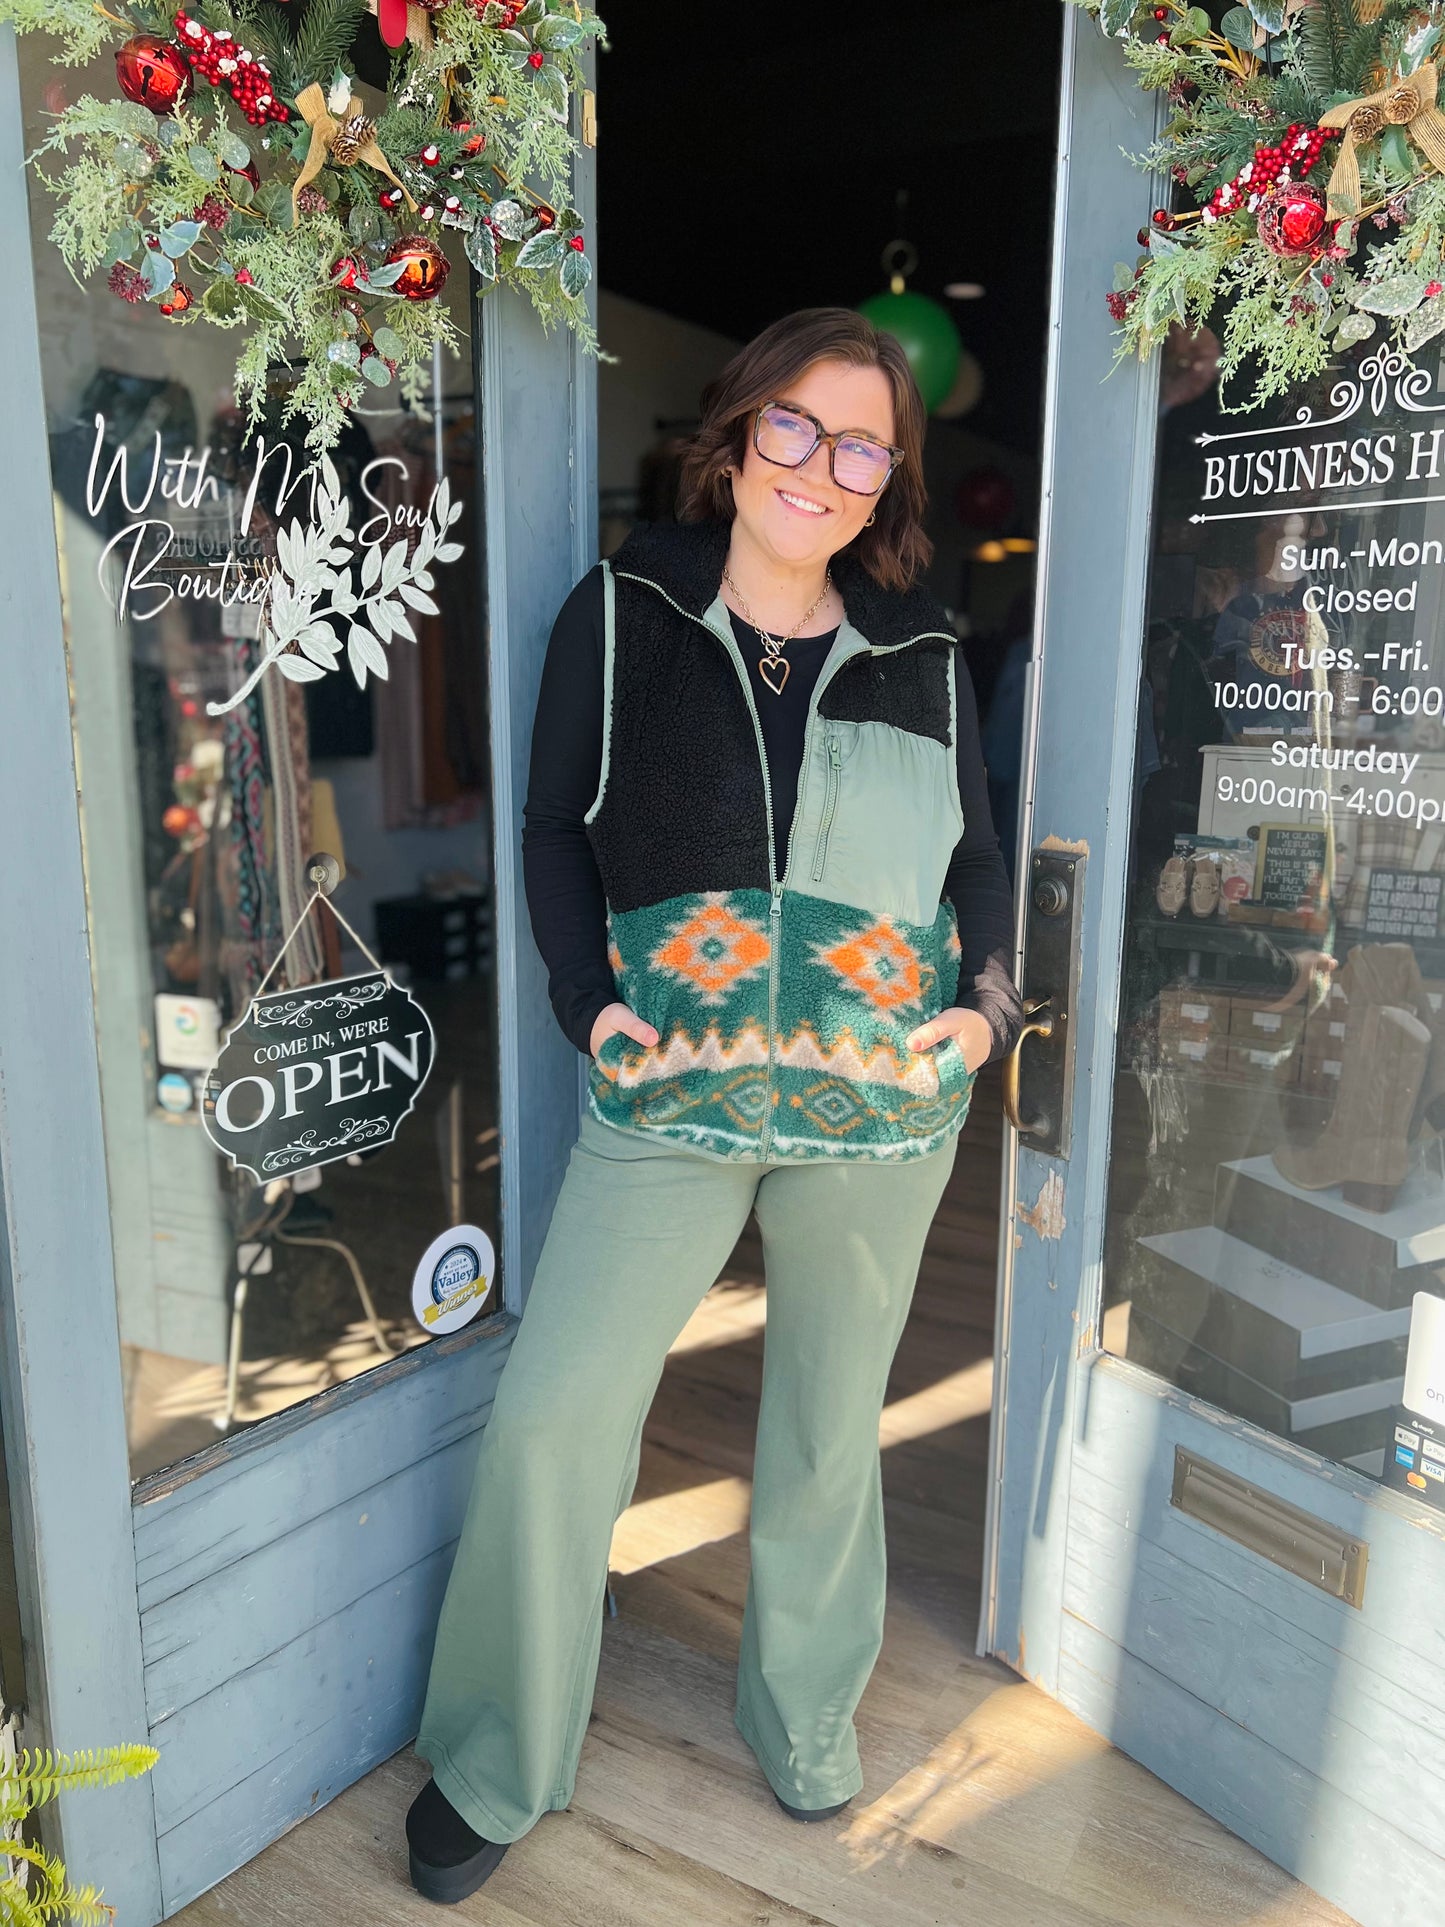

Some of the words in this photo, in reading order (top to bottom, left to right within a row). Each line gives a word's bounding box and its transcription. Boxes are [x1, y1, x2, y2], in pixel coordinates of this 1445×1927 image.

[87, 413, 218, 517] With
[1202, 435, 1396, 500] BUSINESS
[1302, 581, 1417, 613] Closed
[1213, 682, 1334, 712] 10:00am
[1371, 685, 1445, 728] 6:00
[1271, 740, 1419, 784] Saturday
[1217, 775, 1445, 829] 9:00am-4:00p
[1267, 847, 1297, 856] NEVER
[1292, 832, 1318, 841] GLAD
[253, 1037, 309, 1064] COME
[311, 1031, 335, 1051] IN,
[339, 1016, 390, 1042] WE'RE
[215, 1031, 424, 1133] OPEN
[438, 1268, 473, 1289] Valley
[438, 1284, 477, 1316] Winner
[1425, 1464, 1442, 1477] VISA
